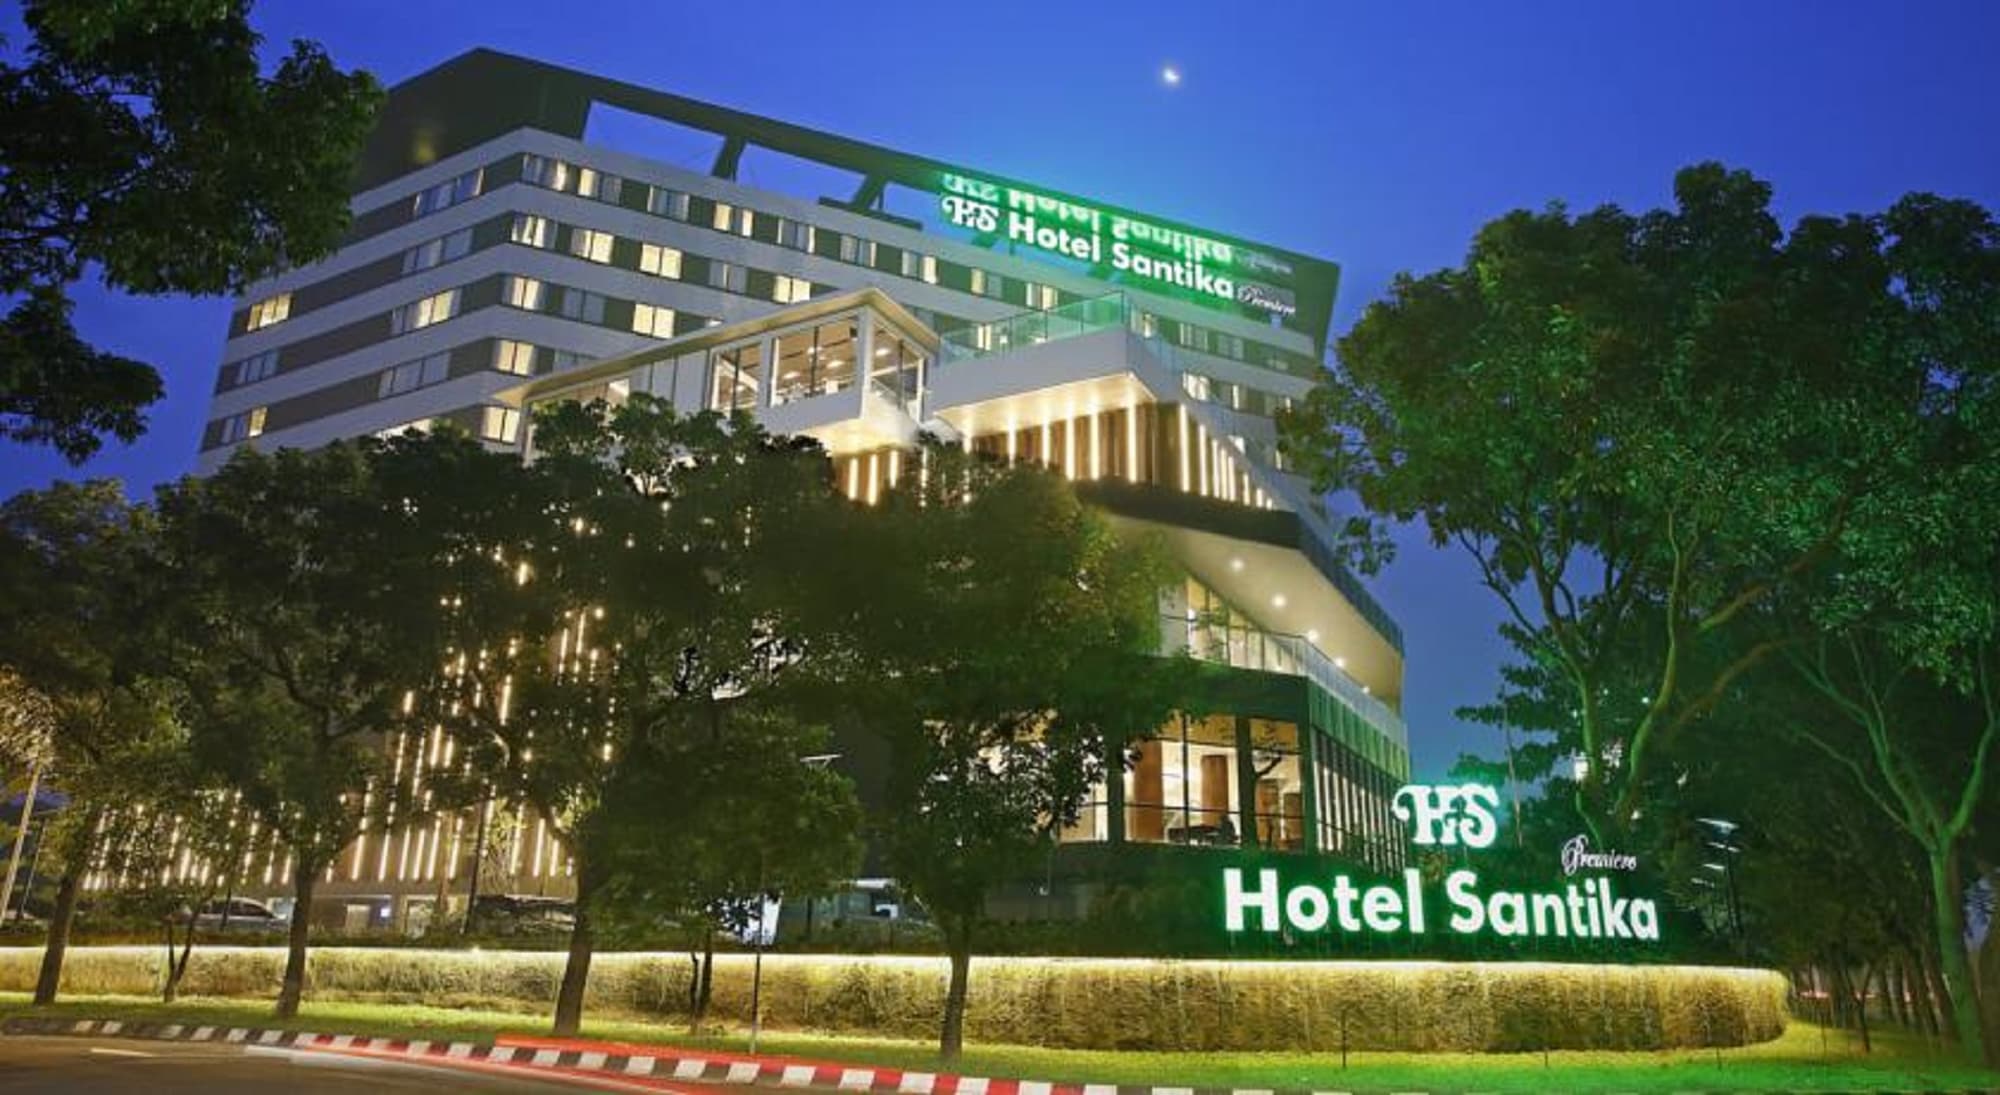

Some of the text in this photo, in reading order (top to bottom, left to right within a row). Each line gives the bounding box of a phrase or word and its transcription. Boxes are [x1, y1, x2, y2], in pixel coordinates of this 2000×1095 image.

[1008, 211, 1101, 262] Hotel
[1112, 243, 1234, 300] Santika
[1223, 867, 1660, 940] Hotel Santika
